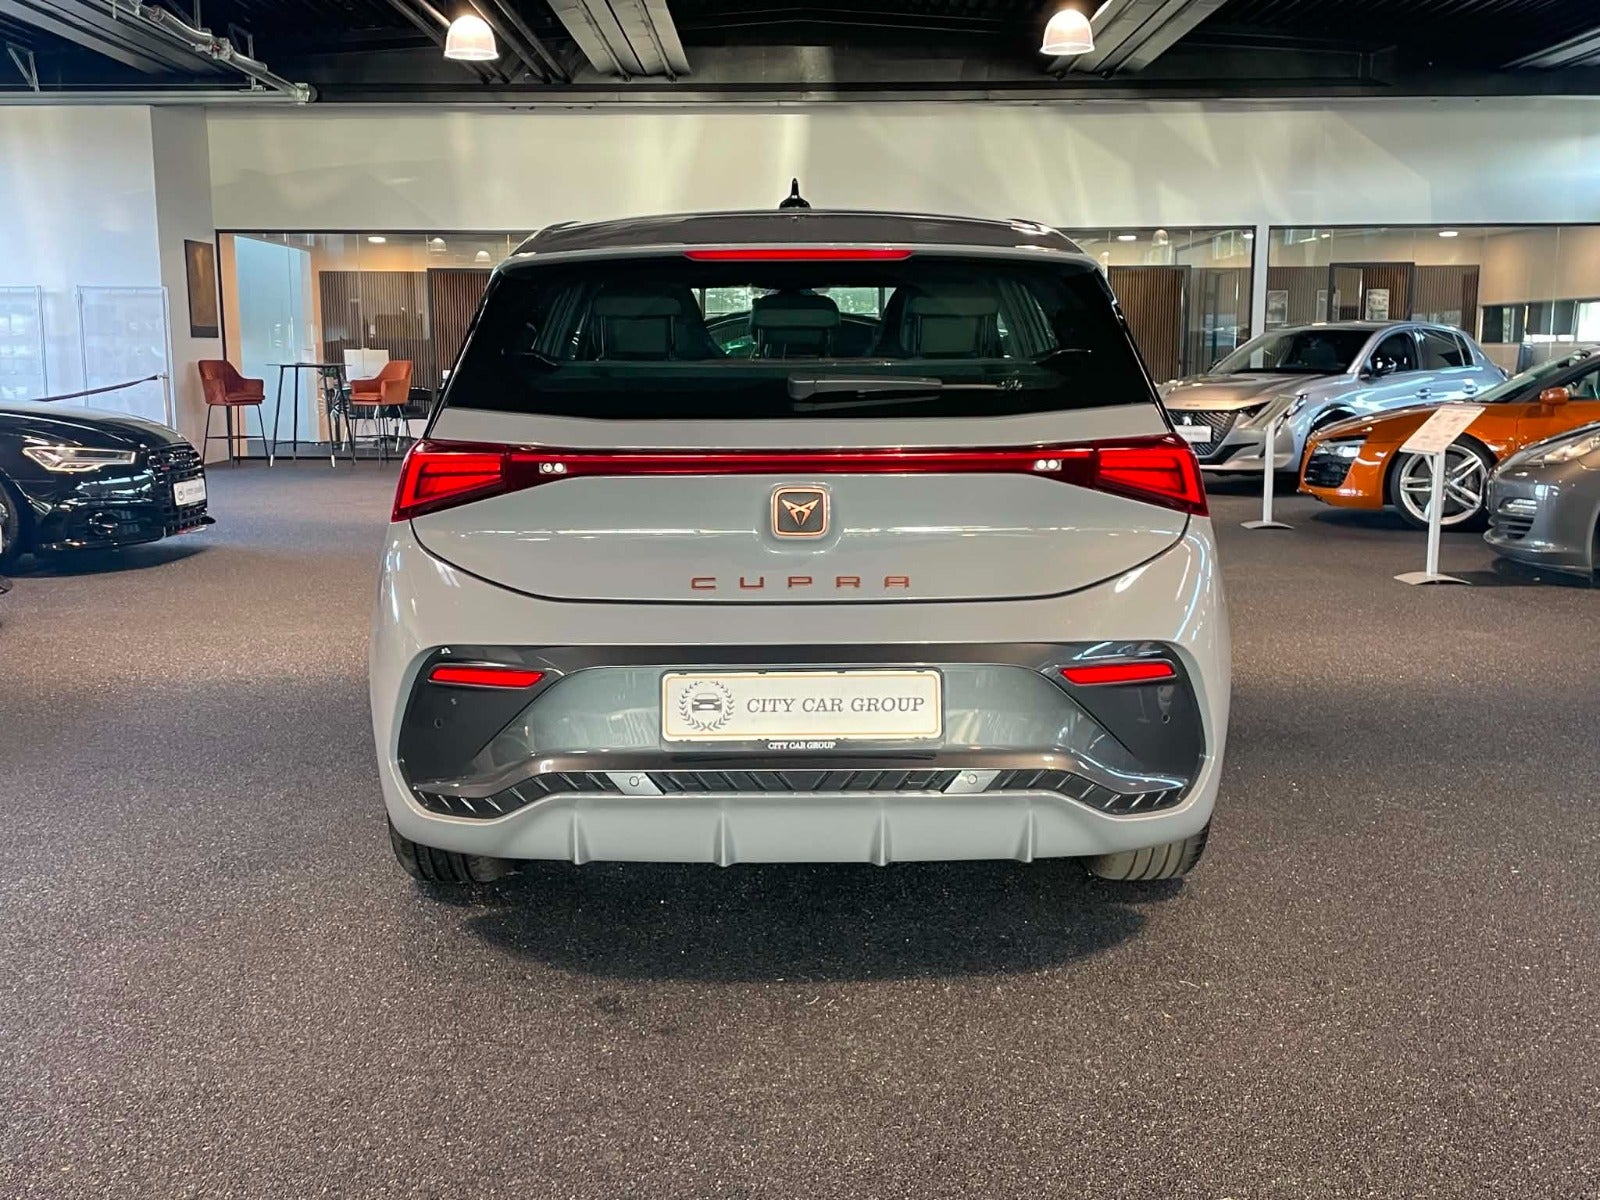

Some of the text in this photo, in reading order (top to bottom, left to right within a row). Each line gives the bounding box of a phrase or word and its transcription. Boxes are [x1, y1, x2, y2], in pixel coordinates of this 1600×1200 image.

[690, 576, 910, 591] CUPRA
[746, 697, 925, 713] CITY CAR GROUP
[768, 742, 836, 750] CITY CAR GROUP
